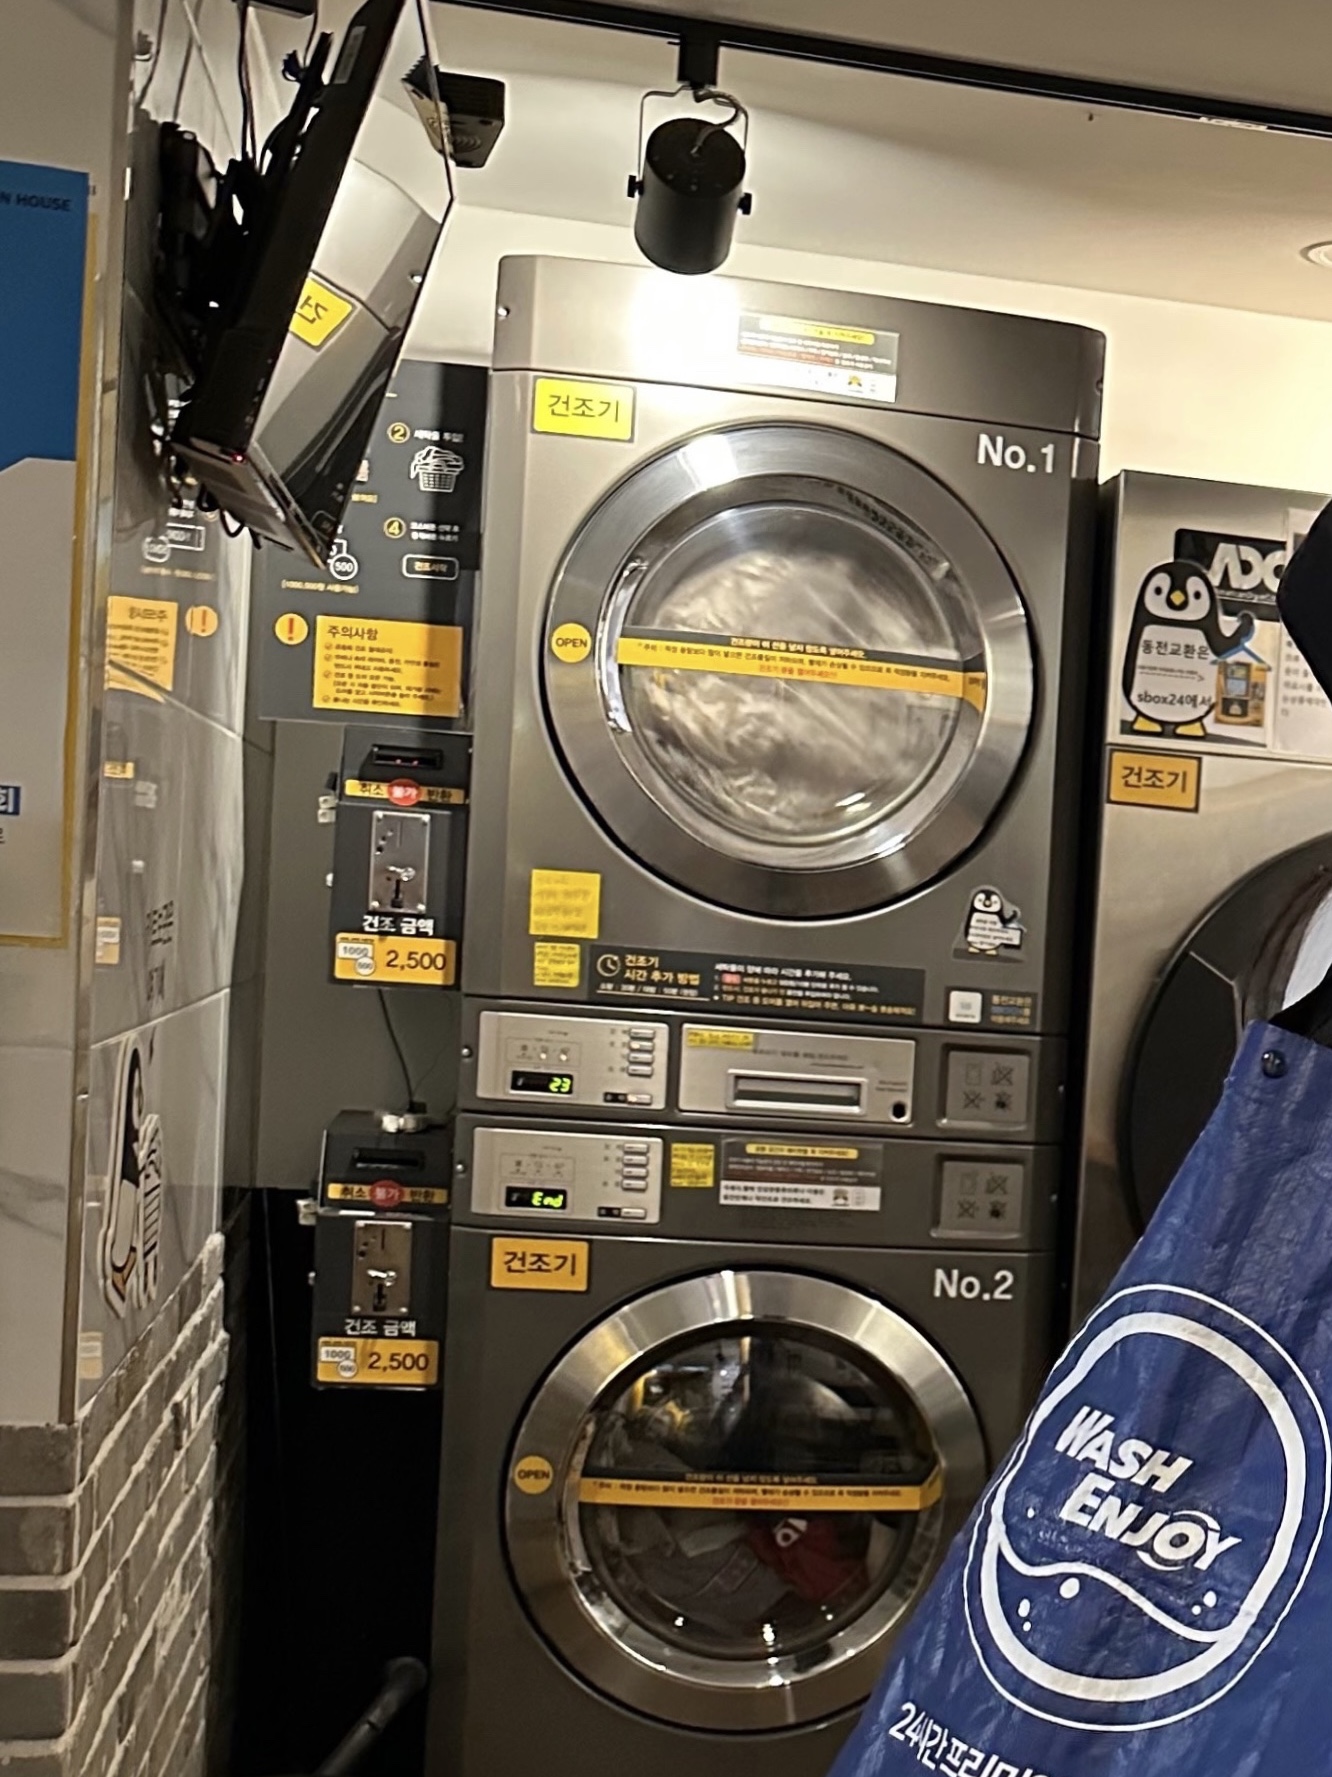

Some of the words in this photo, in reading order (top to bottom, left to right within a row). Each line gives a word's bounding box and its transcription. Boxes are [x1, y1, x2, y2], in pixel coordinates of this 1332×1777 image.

[16, 193, 71, 212] HOUSE
[547, 391, 622, 425] 건조기
[977, 433, 1055, 474] No.1
[335, 561, 353, 572] 500
[327, 625, 378, 641] 주의사항
[555, 634, 588, 652] OPEN
[1141, 639, 1210, 660] 동전교환은
[1137, 690, 1213, 709] sbox24에서
[1121, 765, 1188, 794] 건조기
[359, 782, 384, 796] 취소
[391, 786, 418, 799] 불가
[362, 915, 396, 932] 건조
[400, 918, 434, 936] 금액
[342, 945, 369, 957] 1000
[386, 949, 447, 971] 2,500
[625, 954, 659, 968] 건조기
[624, 969, 647, 981] 시간
[651, 970, 674, 984] 추가
[677, 973, 700, 986] 방법
[549, 1077, 572, 1092] 23
[340, 1185, 367, 1199] 취소
[503, 1250, 577, 1280] 건조기
[933, 1269, 1014, 1302] No.2
[345, 1319, 378, 1335] 건조
[383, 1320, 417, 1337] 금액
[368, 1352, 429, 1372] 2,500
[1055, 1405, 1194, 1493] WASH
[517, 1468, 551, 1482] OPEN
[1059, 1472, 1242, 1571] ENJOY
